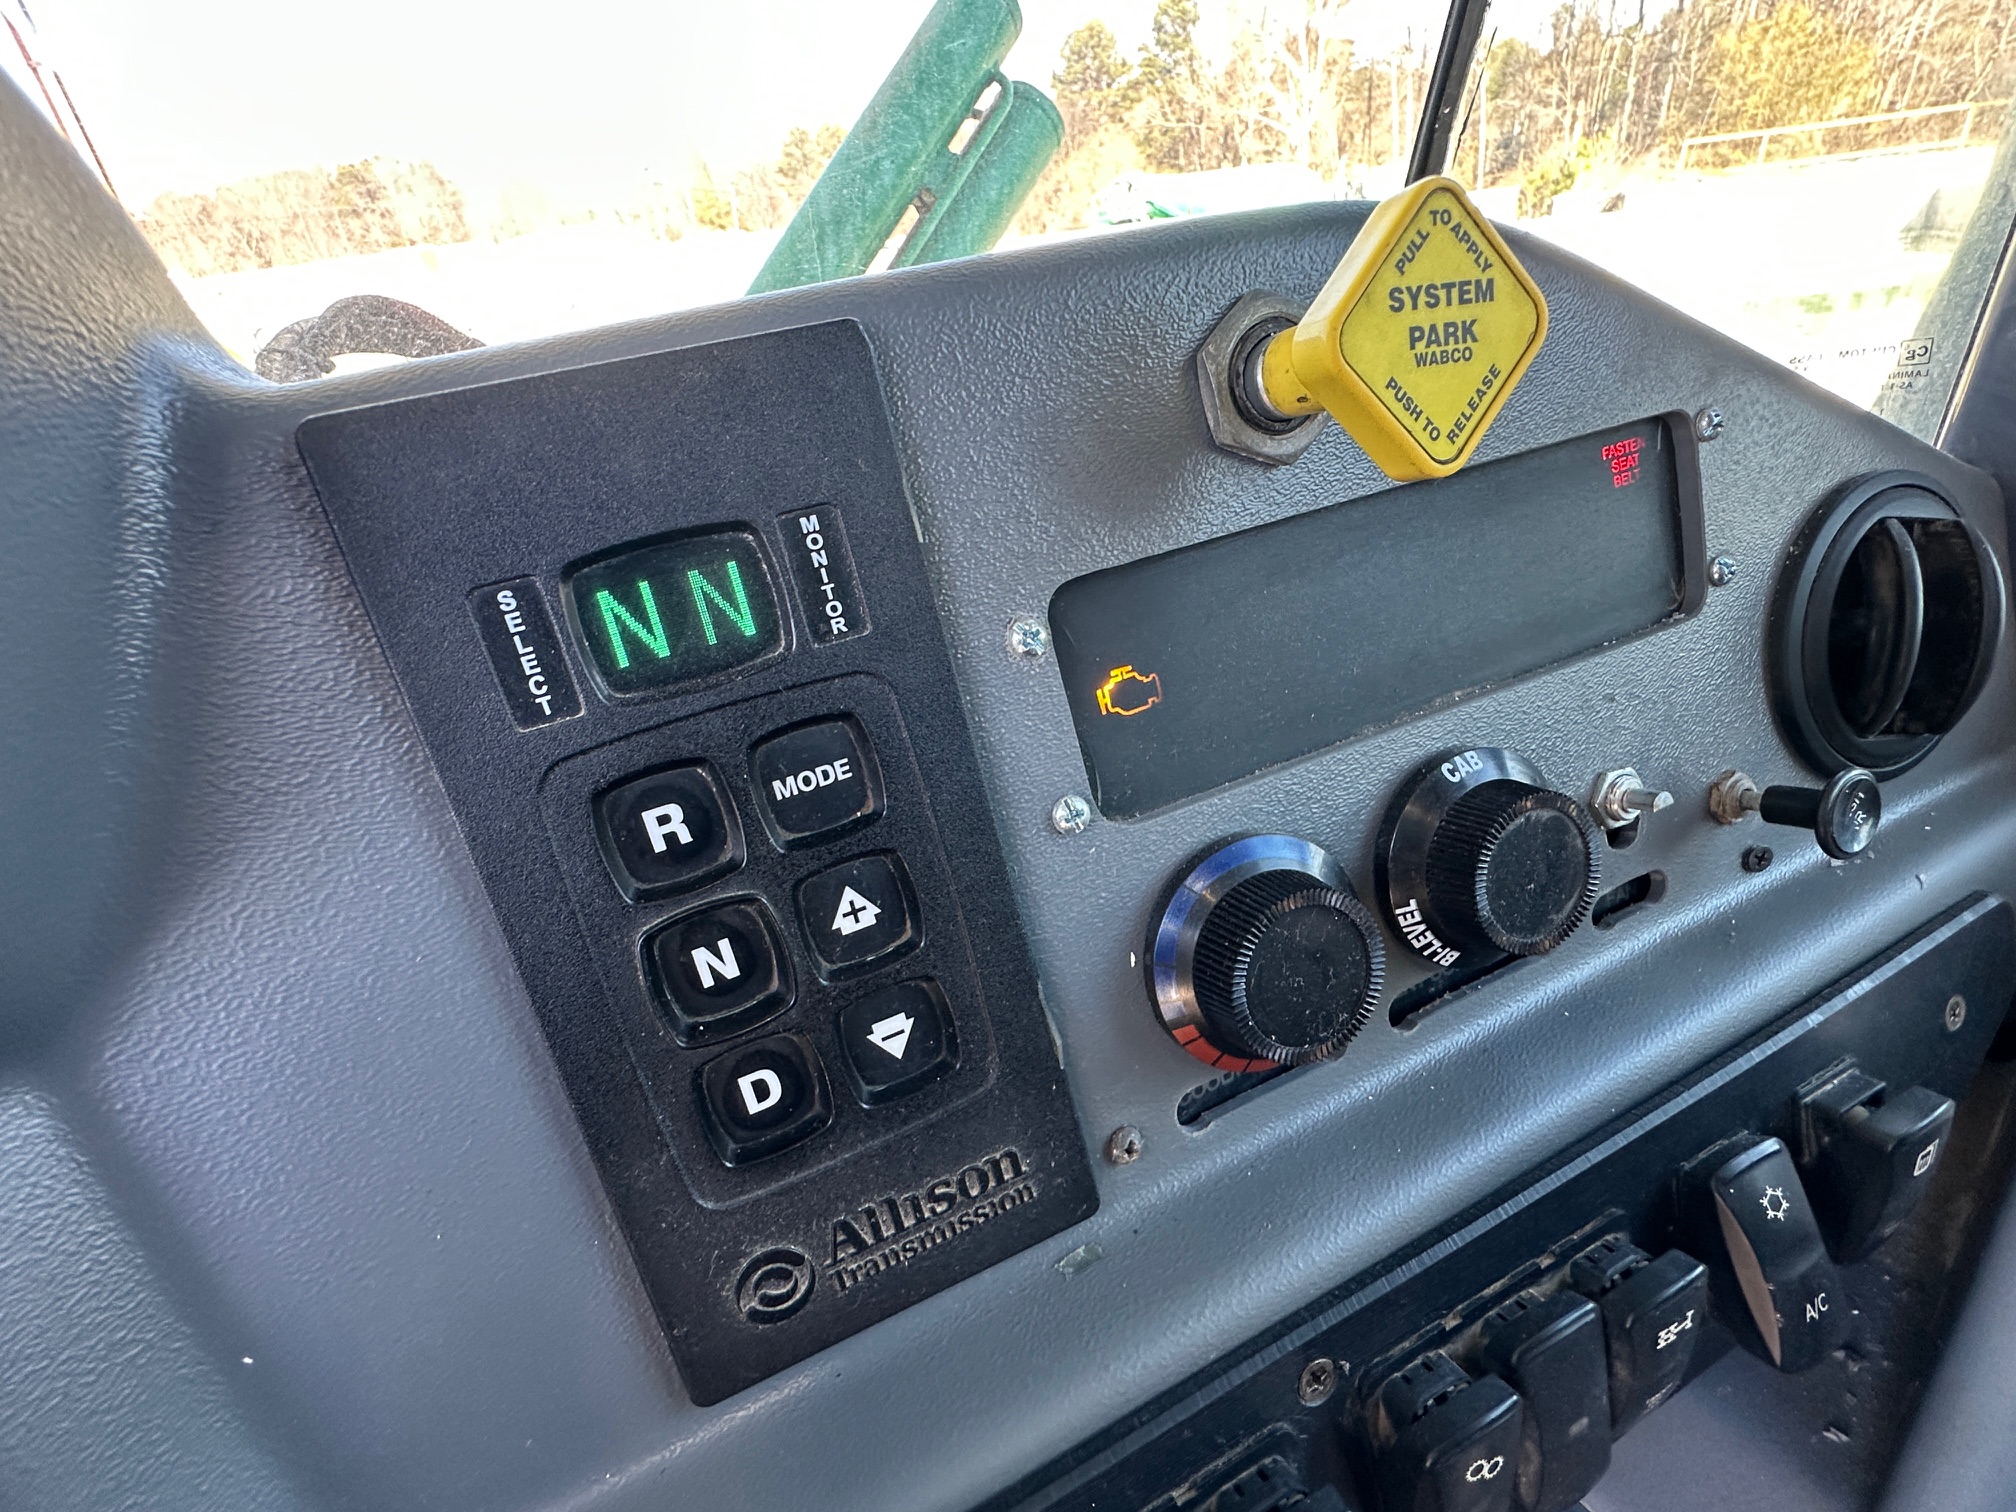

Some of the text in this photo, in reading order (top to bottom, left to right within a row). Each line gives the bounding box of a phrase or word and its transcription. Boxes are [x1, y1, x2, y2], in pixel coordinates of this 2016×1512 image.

[1395, 208, 1493, 276] PULL TO APPLY
[1388, 278, 1495, 313] SYSTEM
[1409, 319, 1478, 350] PARK
[1414, 346, 1473, 368] WABCO
[1385, 363, 1501, 446] PUSH TO RELEASE
[1601, 437, 1646, 461] FASTEN
[1611, 453, 1640, 473] SEAT
[1613, 468, 1641, 488] BELT
[799, 514, 848, 634] MONITOR
[496, 589, 551, 716] SELECT
[772, 757, 853, 801] MODE
[1441, 750, 1484, 783] CAB
[641, 803, 693, 853] R
[1395, 898, 1461, 967] BI-LEVEL
[691, 937, 741, 989] N
[737, 1068, 783, 1115] D
[824, 1147, 1028, 1266] Allison
[828, 1180, 1038, 1292] Transmission
[1806, 1292, 1829, 1323] A/C
